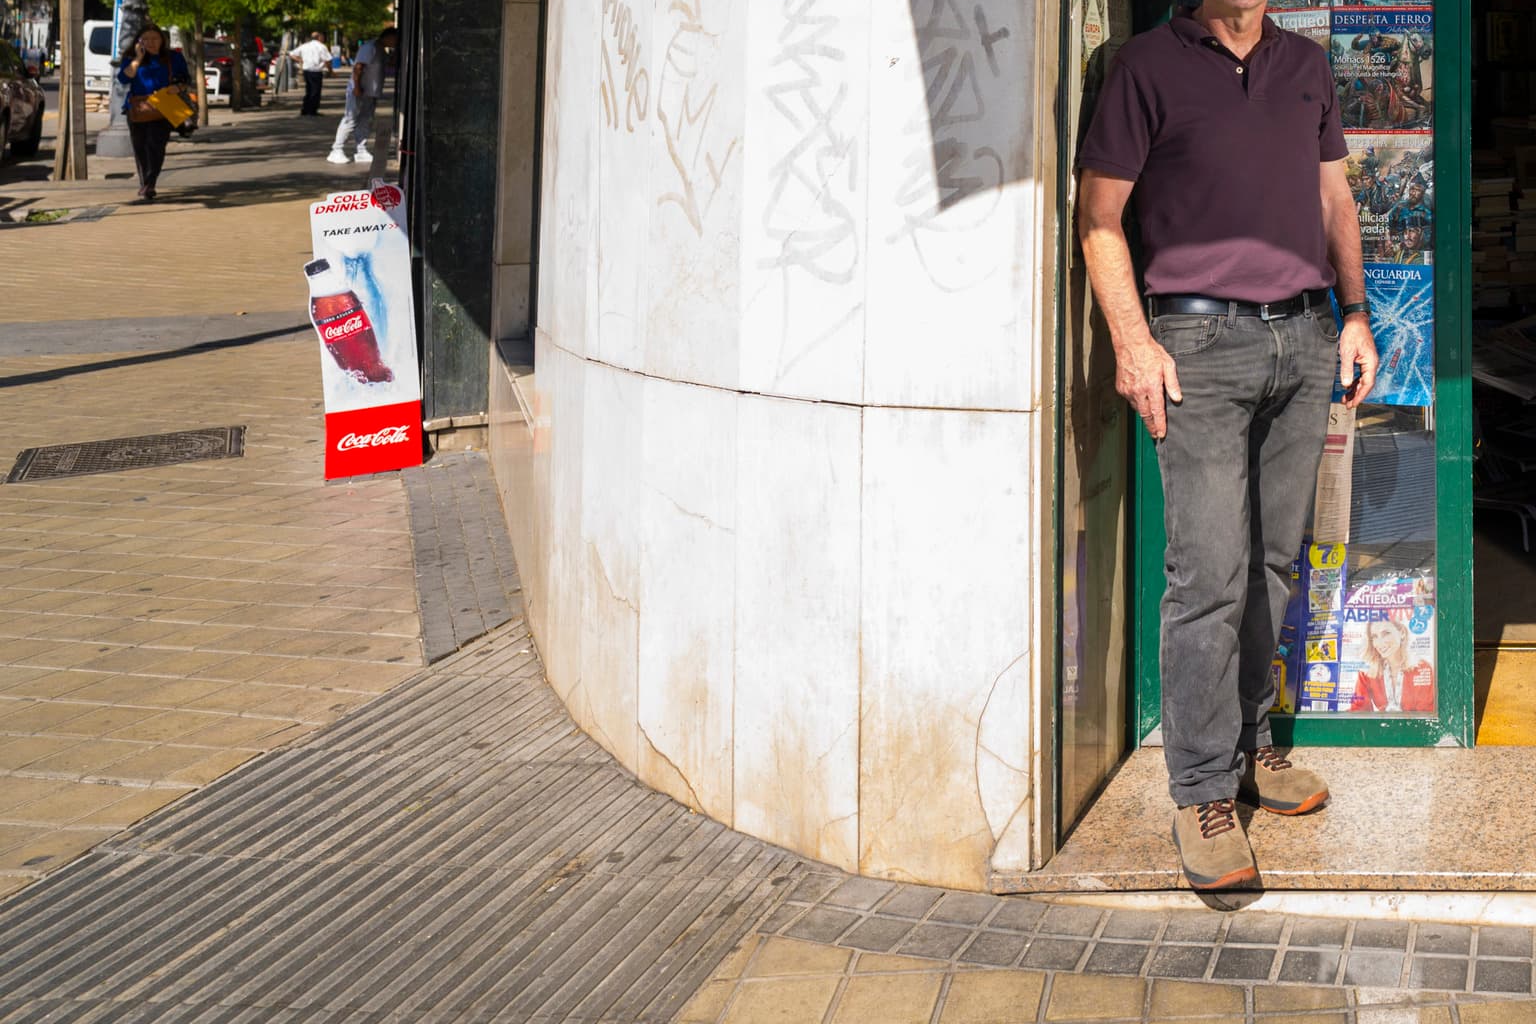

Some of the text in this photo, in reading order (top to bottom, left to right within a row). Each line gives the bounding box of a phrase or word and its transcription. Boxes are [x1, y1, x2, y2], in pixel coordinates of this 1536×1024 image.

[1272, 14, 1330, 33] Arqueol
[1335, 15, 1432, 25] DESPERTA FERRO
[333, 193, 369, 204] COLD
[315, 201, 369, 215] DRINKS
[323, 223, 387, 238] TAKE AWAY
[1364, 268, 1422, 281] NGUARDIA
[325, 314, 363, 340] Coca-Cola
[336, 424, 410, 452] Coca-Cola
